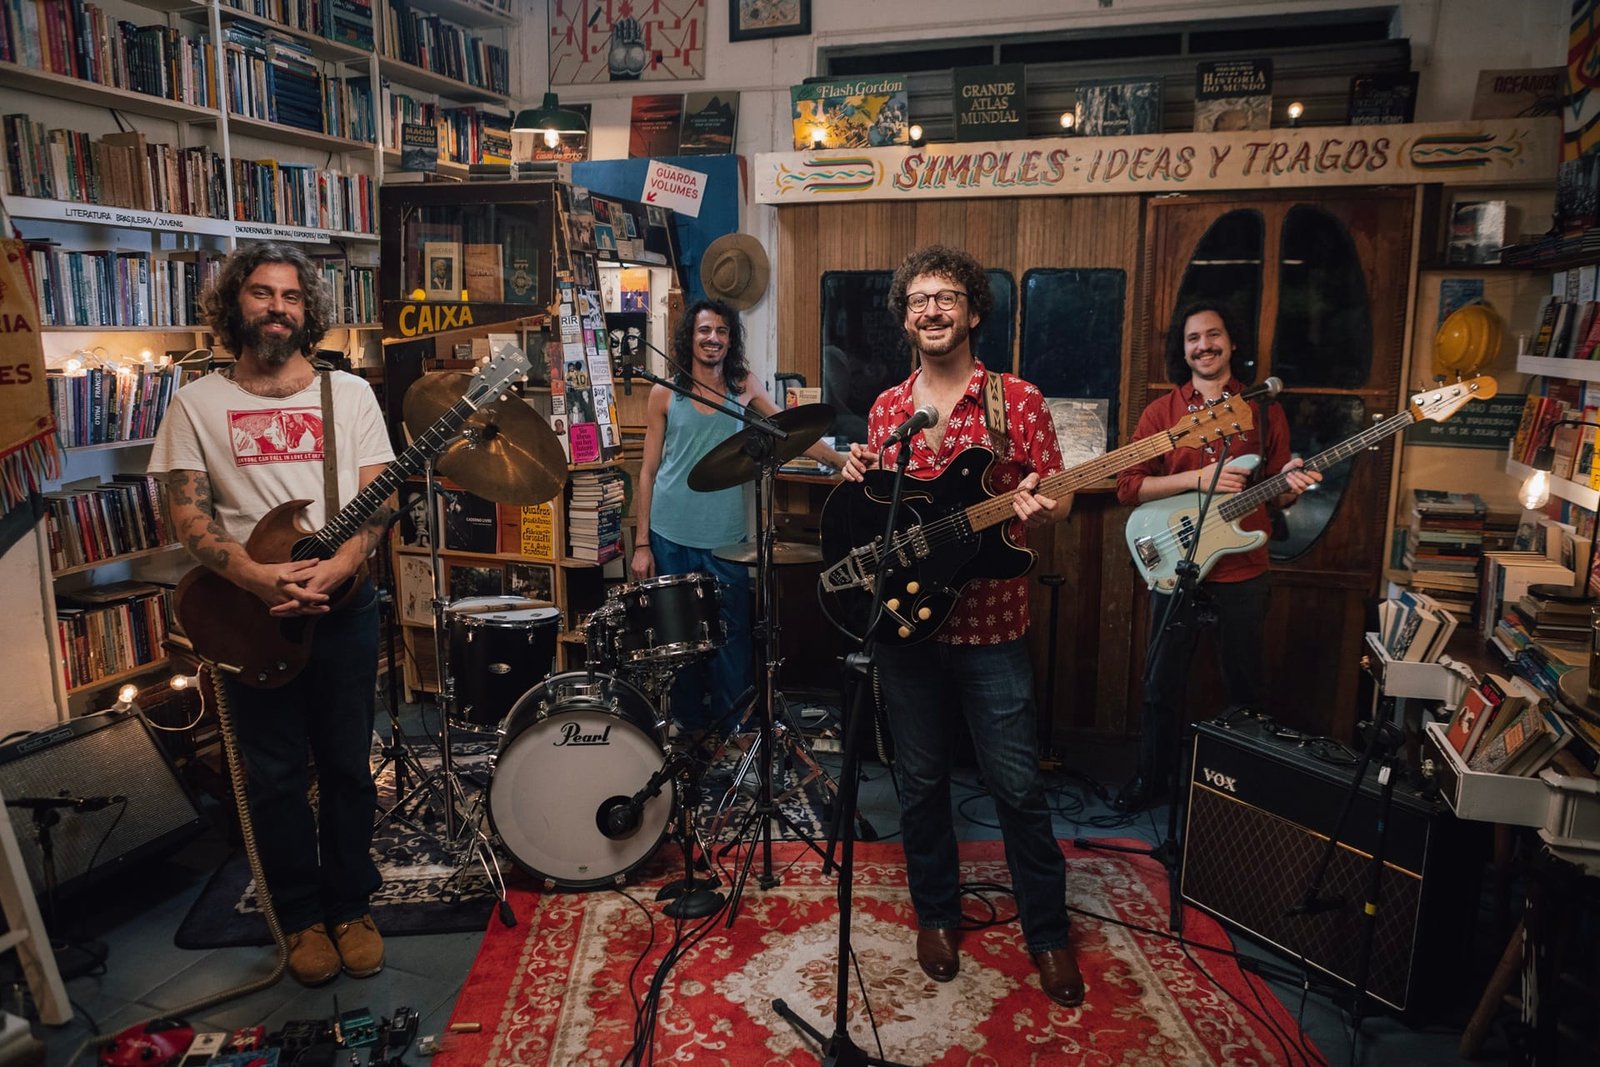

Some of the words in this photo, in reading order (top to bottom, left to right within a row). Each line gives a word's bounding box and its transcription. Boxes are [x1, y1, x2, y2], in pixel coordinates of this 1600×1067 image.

[817, 82, 854, 99] Flash
[855, 78, 903, 96] Gordon
[962, 82, 1015, 98] GRANDE
[970, 96, 1009, 111] ATLAS
[960, 109, 1019, 125] MUNDIAL
[405, 127, 435, 137] MACHU
[405, 135, 435, 144] PICCHU
[1087, 144, 1196, 183] IDEAS
[1208, 144, 1231, 179] Y
[1241, 136, 1391, 176] TRAGOS
[656, 167, 697, 187] GUARDA
[650, 178, 699, 199] VOLUMES
[65, 208, 111, 220] LITERATURA
[399, 305, 474, 337] CAIXA
[94, 372, 103, 399] FRANCIS
[553, 721, 611, 746] Pearl
[1202, 767, 1238, 793] VOX
